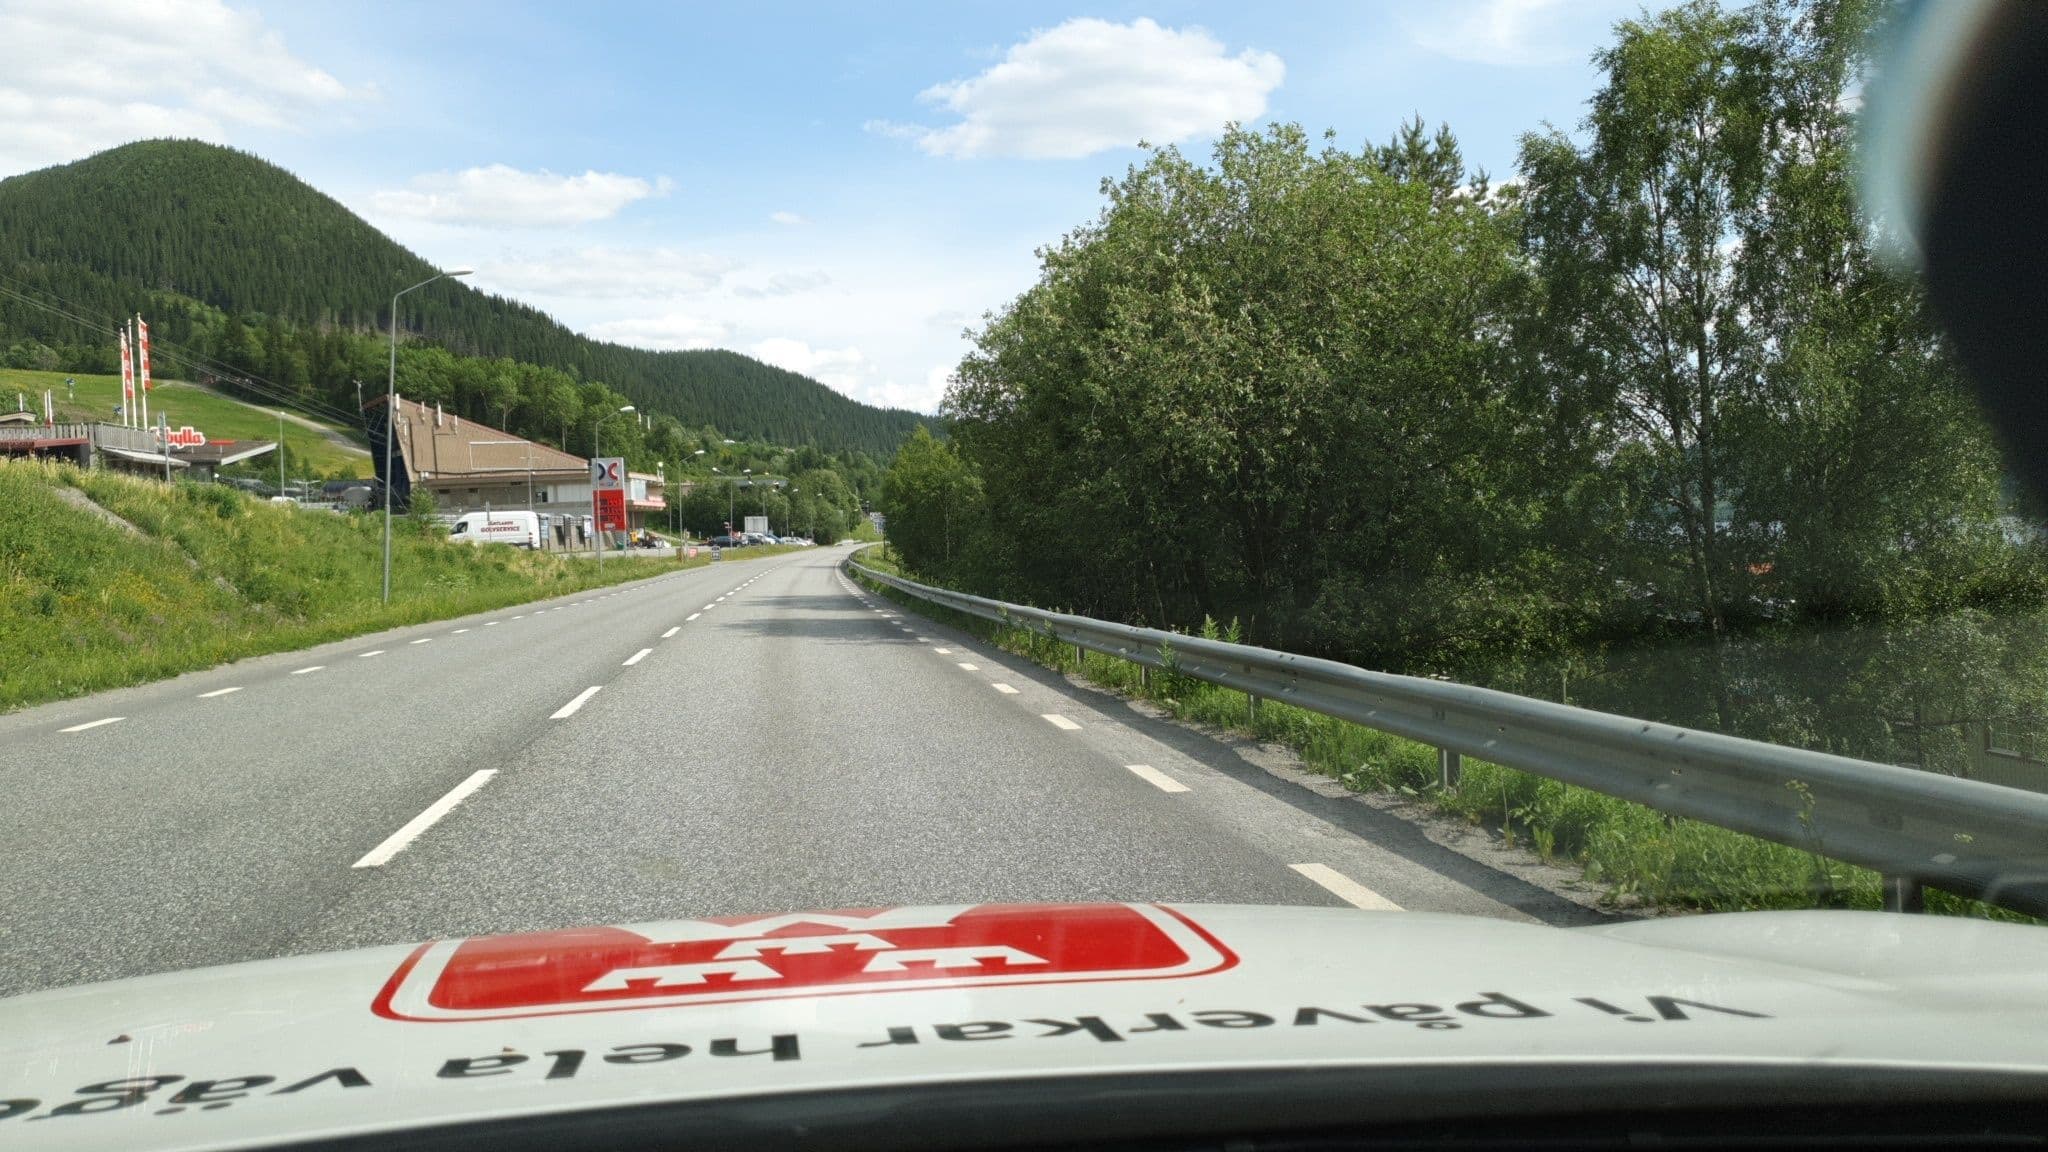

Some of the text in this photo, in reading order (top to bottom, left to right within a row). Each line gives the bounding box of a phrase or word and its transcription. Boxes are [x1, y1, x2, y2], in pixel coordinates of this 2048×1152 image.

[149, 427, 205, 448] bylla
[857, 992, 1554, 1048] påverkar
[1571, 995, 1775, 1022] Vi
[436, 1033, 800, 1079] hela
